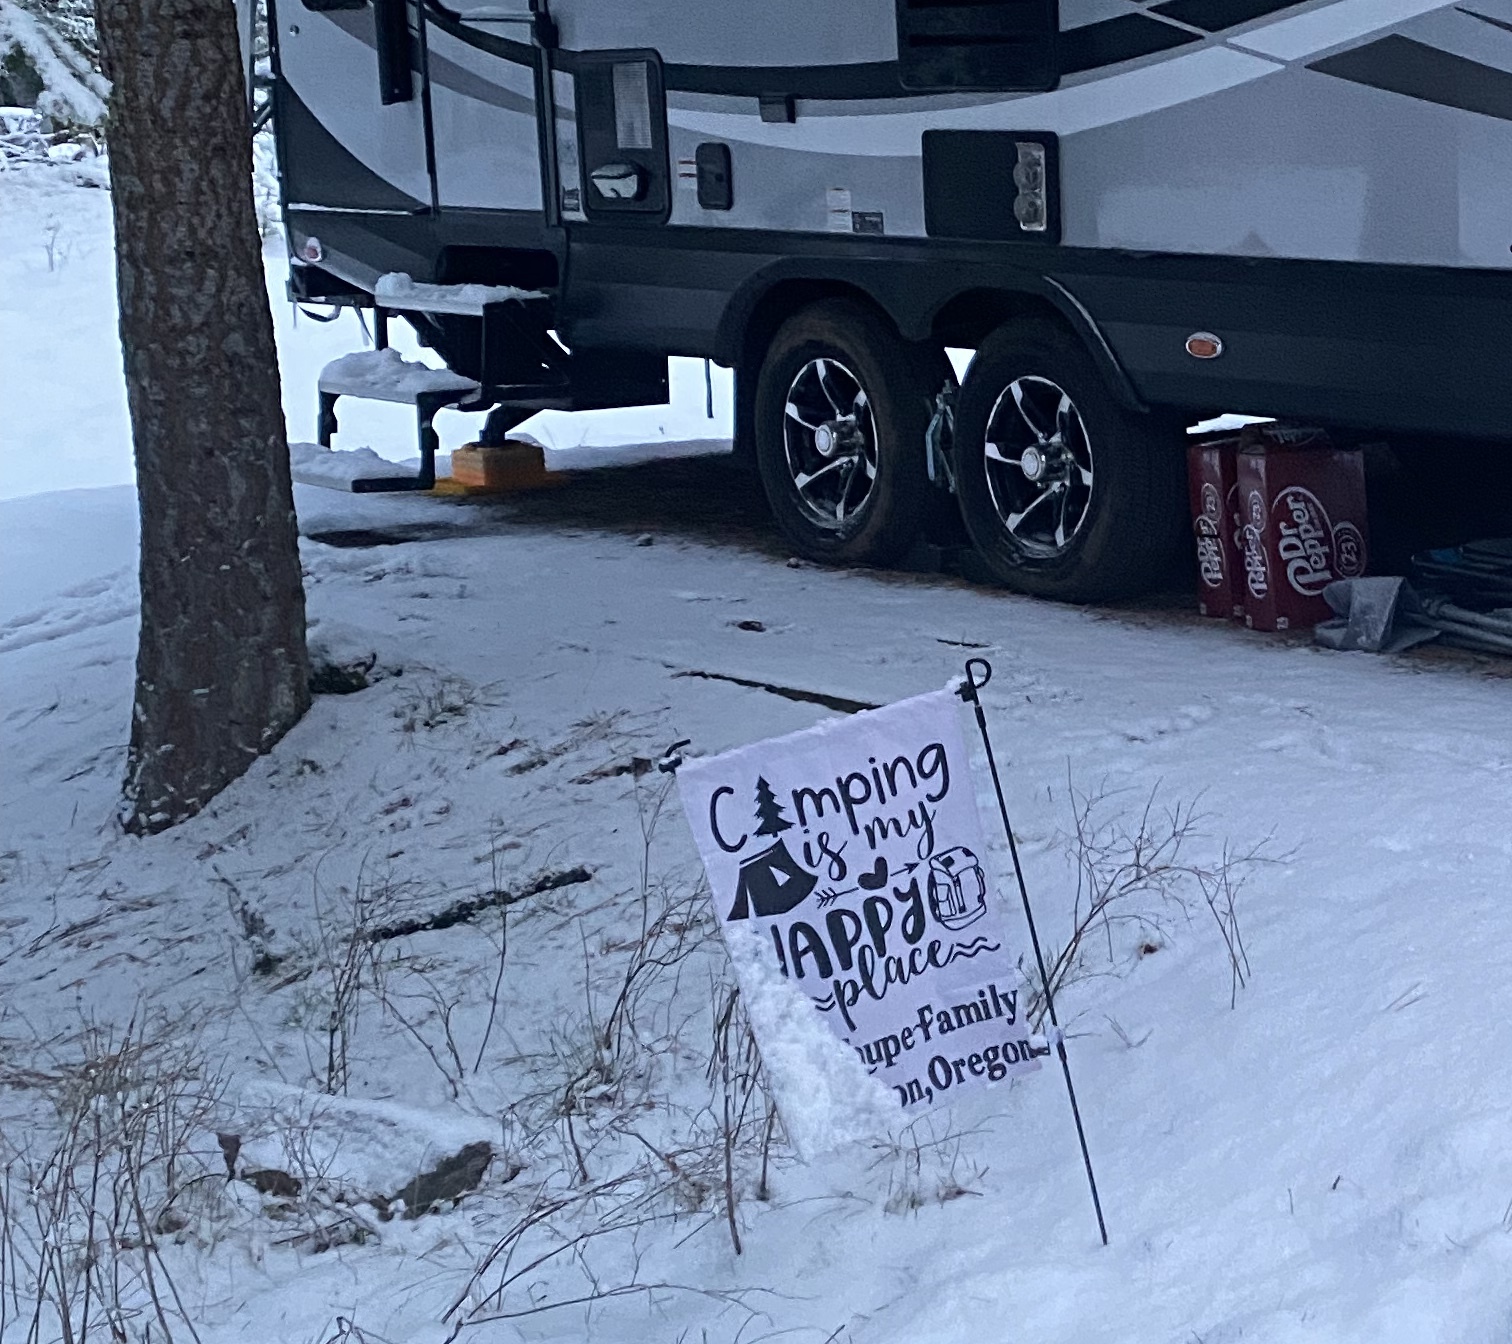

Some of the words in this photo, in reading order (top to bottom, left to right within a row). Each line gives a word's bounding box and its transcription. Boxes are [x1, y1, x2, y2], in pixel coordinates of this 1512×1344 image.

[1279, 521, 1307, 561] Dr
[1286, 494, 1333, 595] Pepper
[710, 743, 950, 853] Cmping
[803, 828, 848, 882] is
[864, 801, 937, 861] my
[833, 939, 955, 1032] place
[913, 984, 1018, 1043] Family
[927, 1039, 1033, 1091] Oregon
